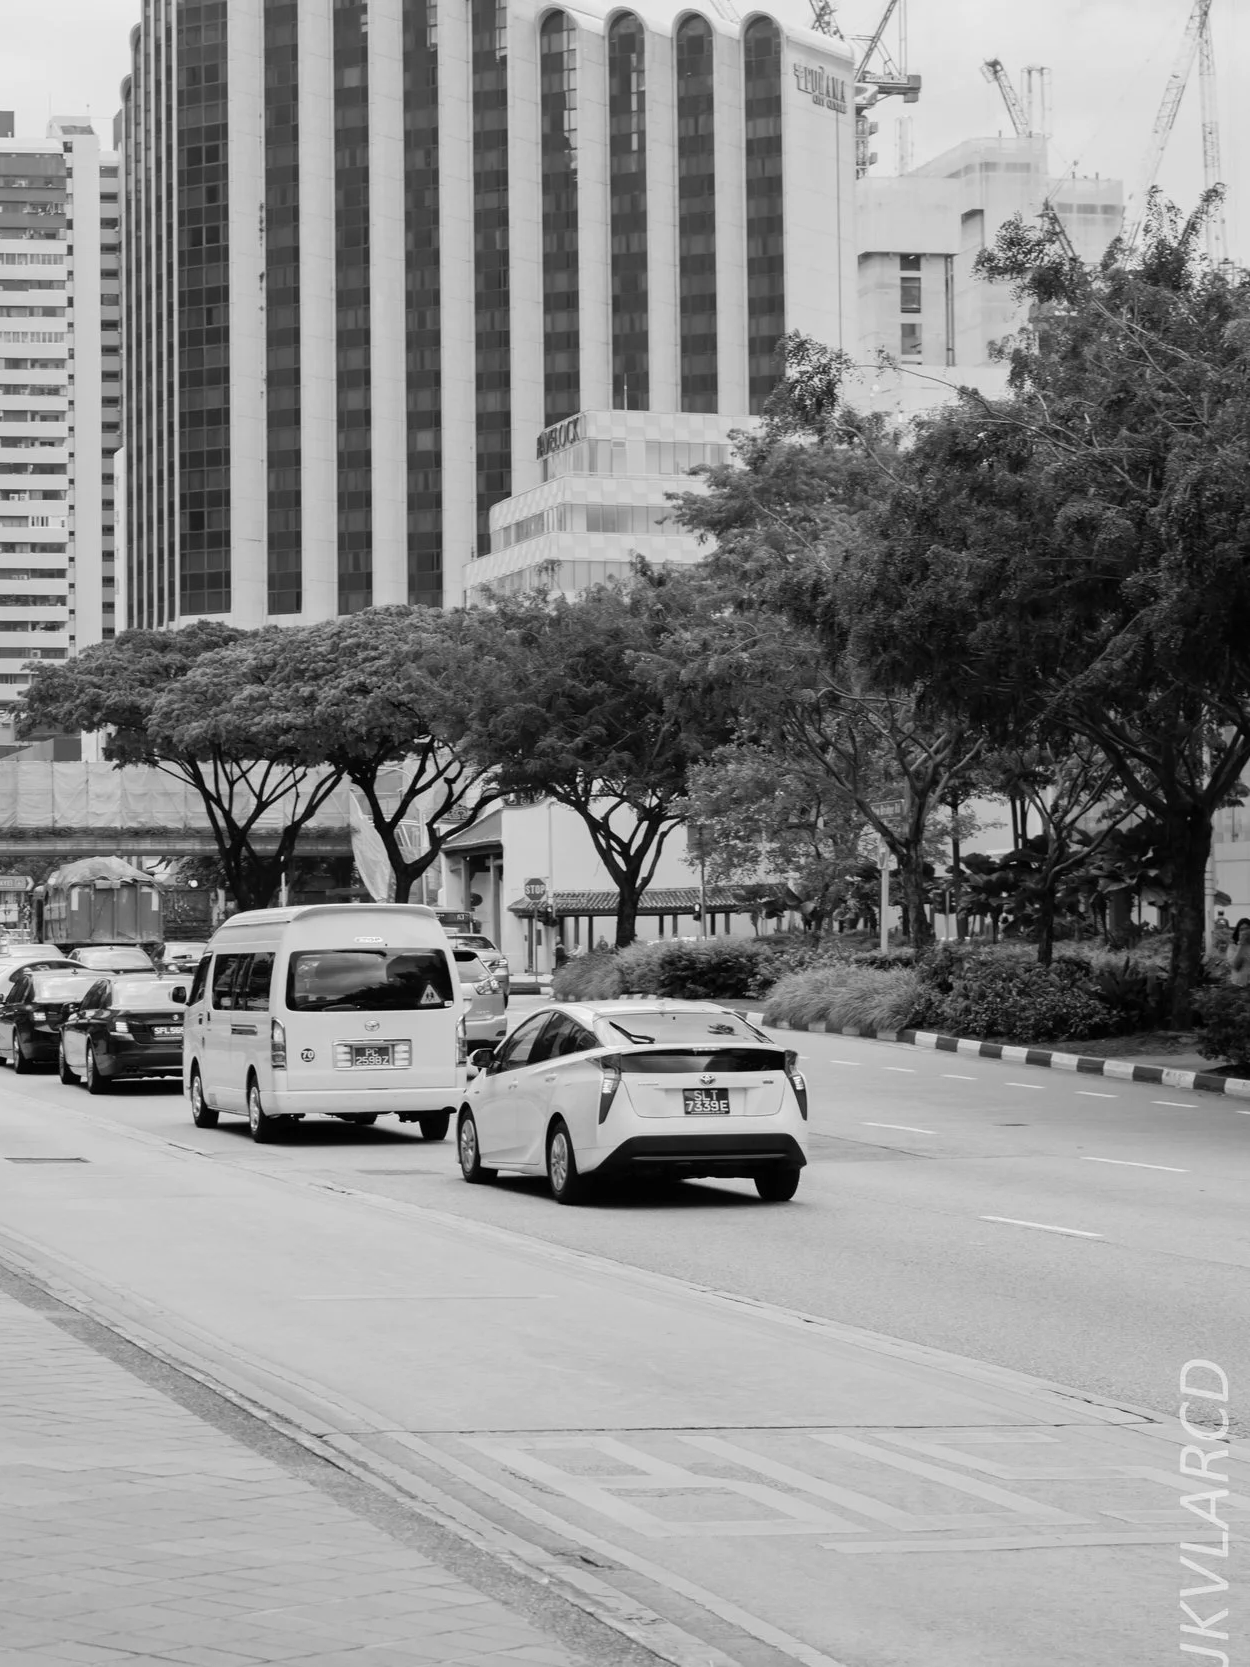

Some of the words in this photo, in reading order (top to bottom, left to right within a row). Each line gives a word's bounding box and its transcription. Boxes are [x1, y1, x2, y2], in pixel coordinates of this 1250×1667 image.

[525, 884, 546, 895] STOP
[302, 1050, 314, 1060] 70
[365, 1048, 379, 1057] PC
[693, 1090, 718, 1101] SLT
[685, 1100, 729, 1112] 7339E
